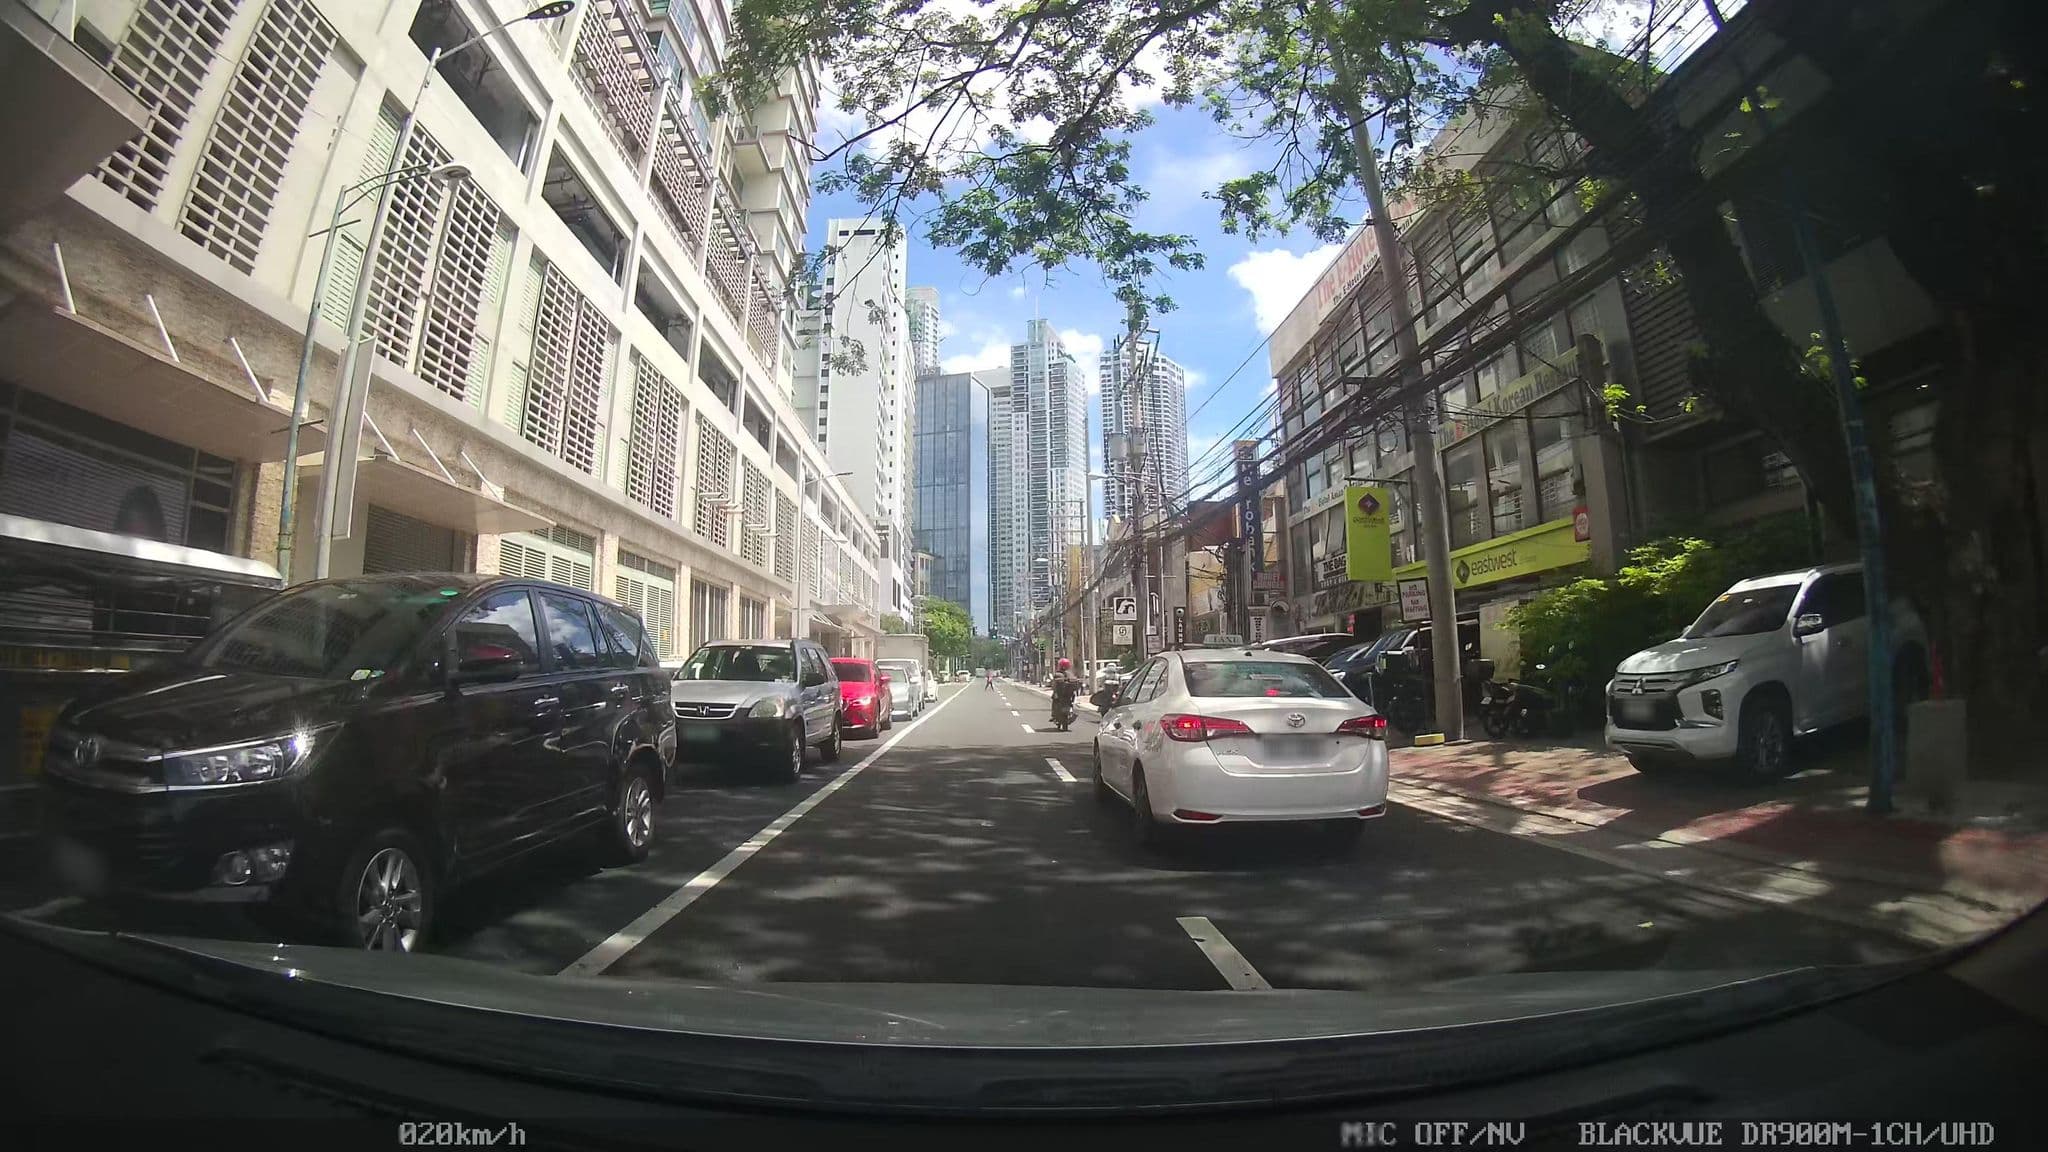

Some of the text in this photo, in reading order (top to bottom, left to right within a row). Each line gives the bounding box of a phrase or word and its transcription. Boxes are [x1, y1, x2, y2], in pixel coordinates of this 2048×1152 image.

[1494, 382, 1534, 418] Korean
[1471, 544, 1518, 576] eastwest
[1213, 635, 1237, 644] TAXI
